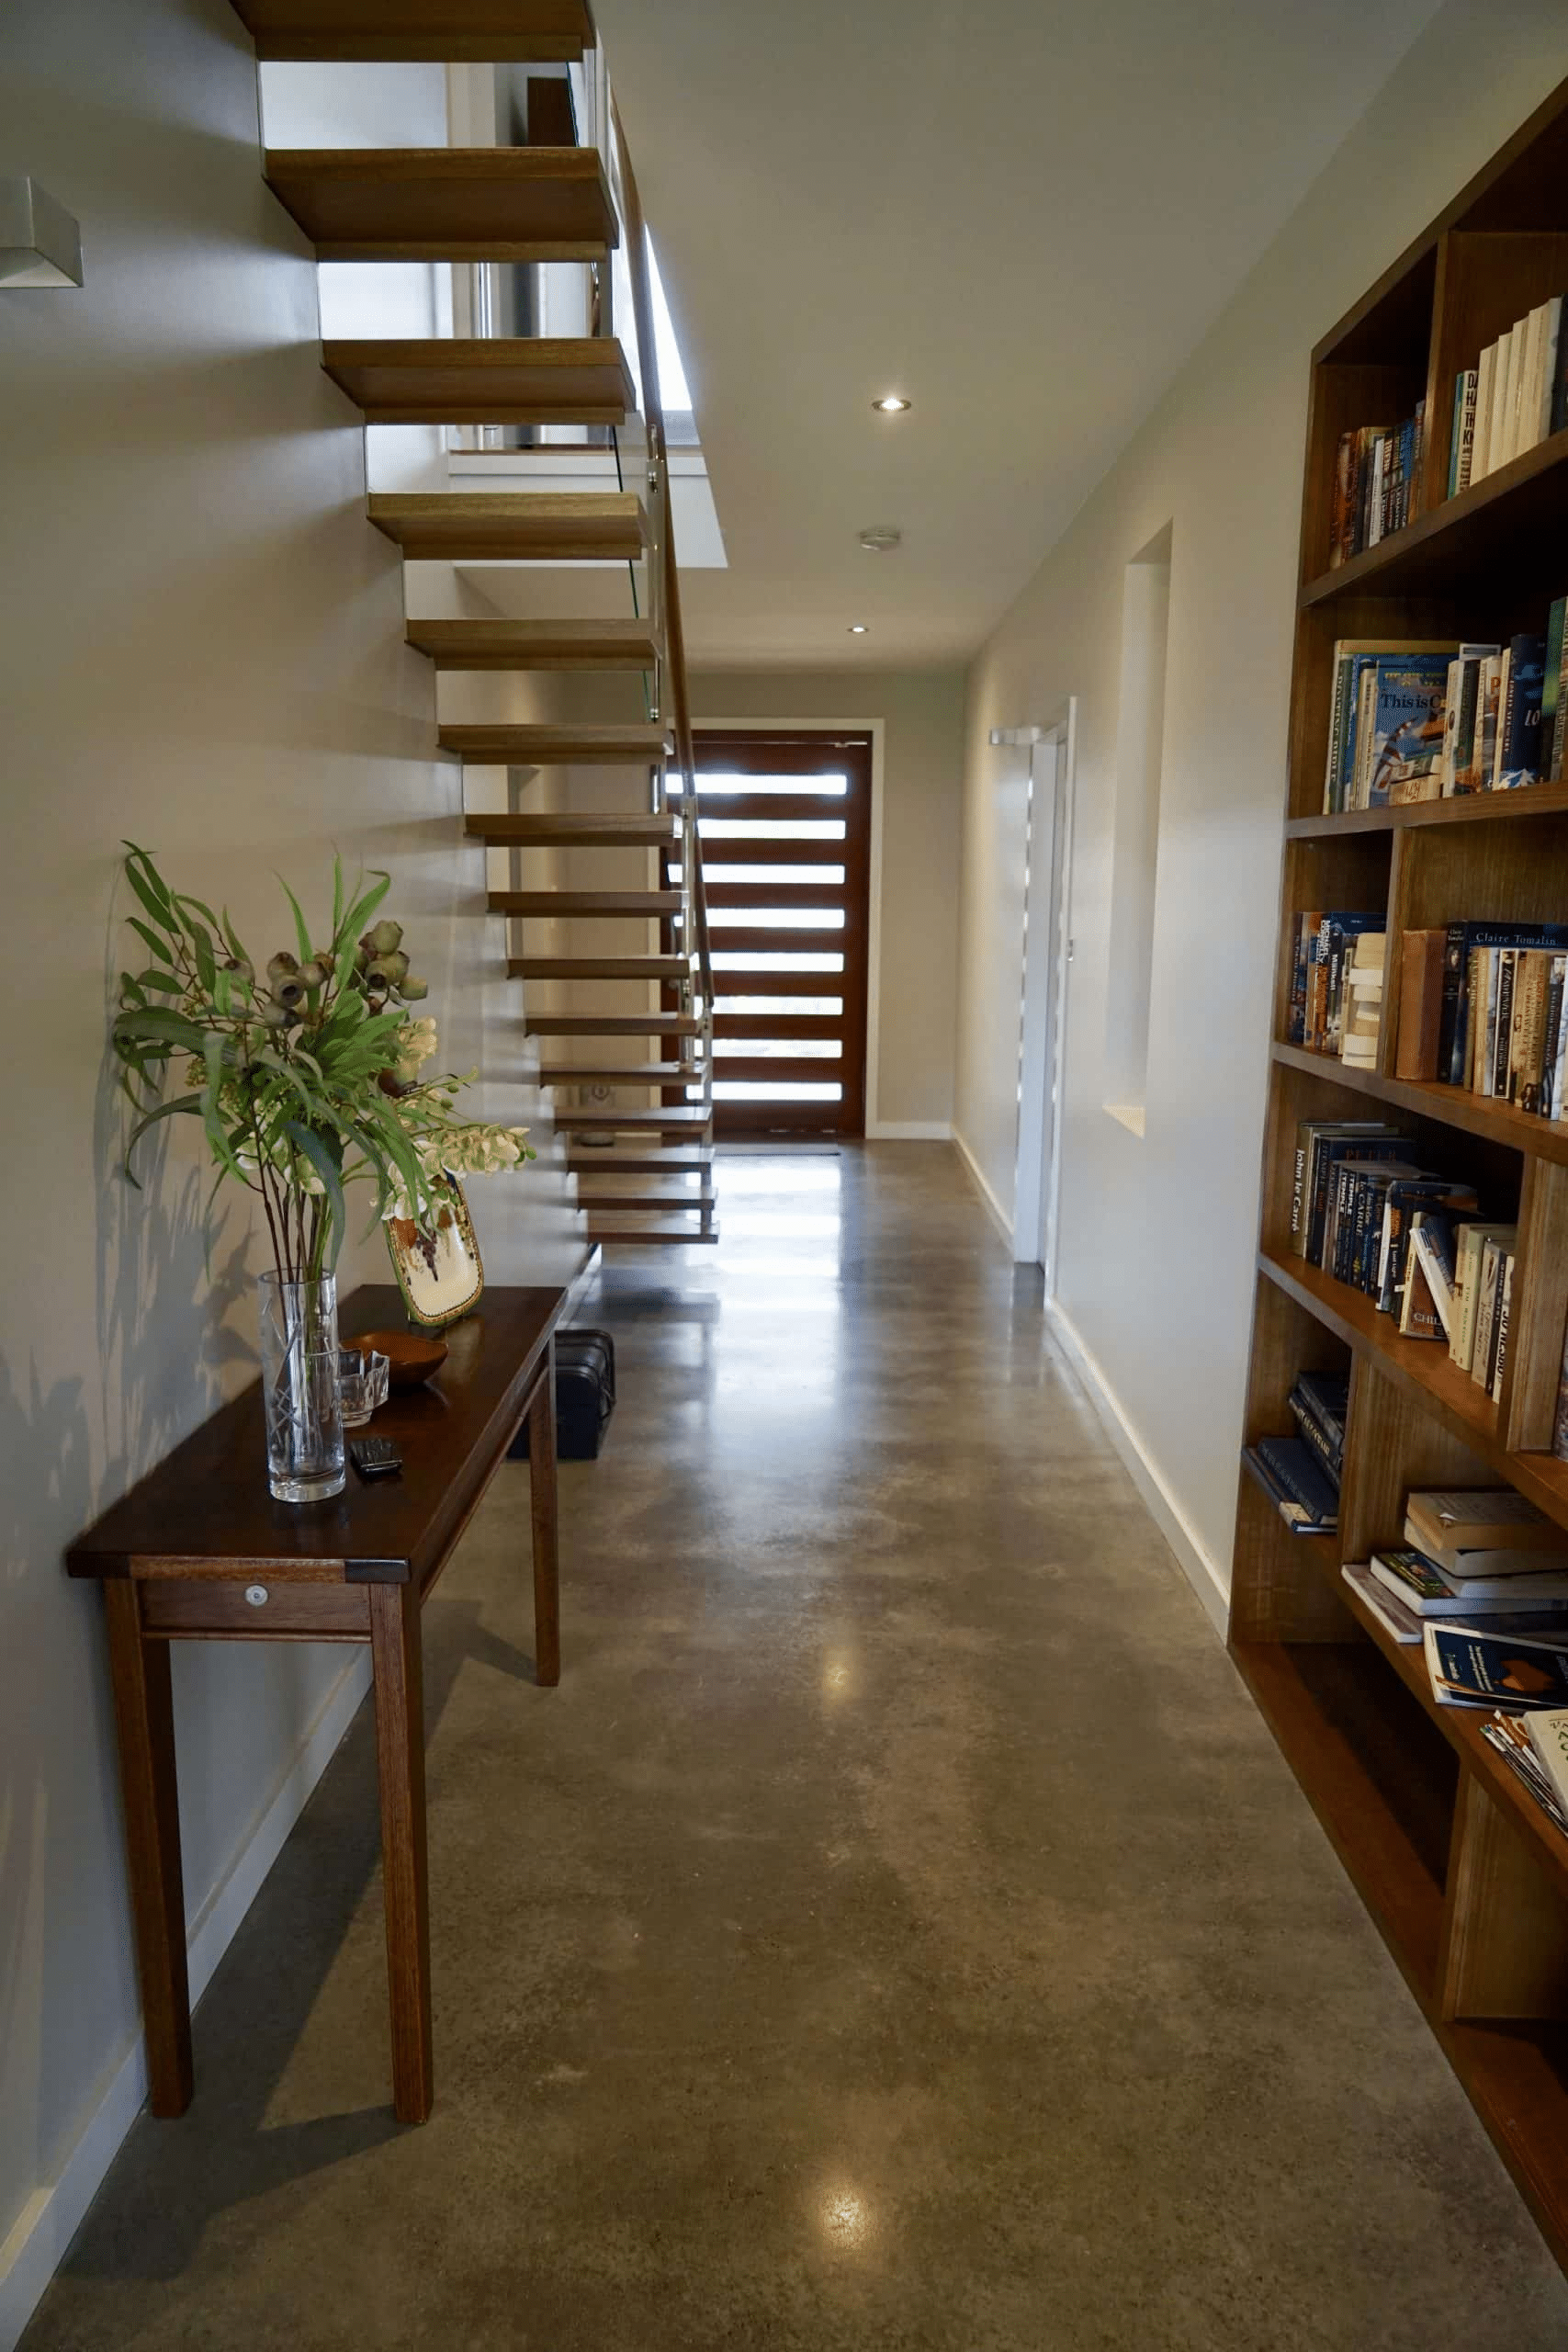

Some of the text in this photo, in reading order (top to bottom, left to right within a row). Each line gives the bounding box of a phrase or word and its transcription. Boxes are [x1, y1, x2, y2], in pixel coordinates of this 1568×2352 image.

[1382, 694, 1414, 708] This
[1416, 694, 1428, 708] is
[1475, 933, 1557, 946] Claire Tomalin
[1295, 1149, 1305, 1179] John
[1294, 1182, 1303, 1193] le
